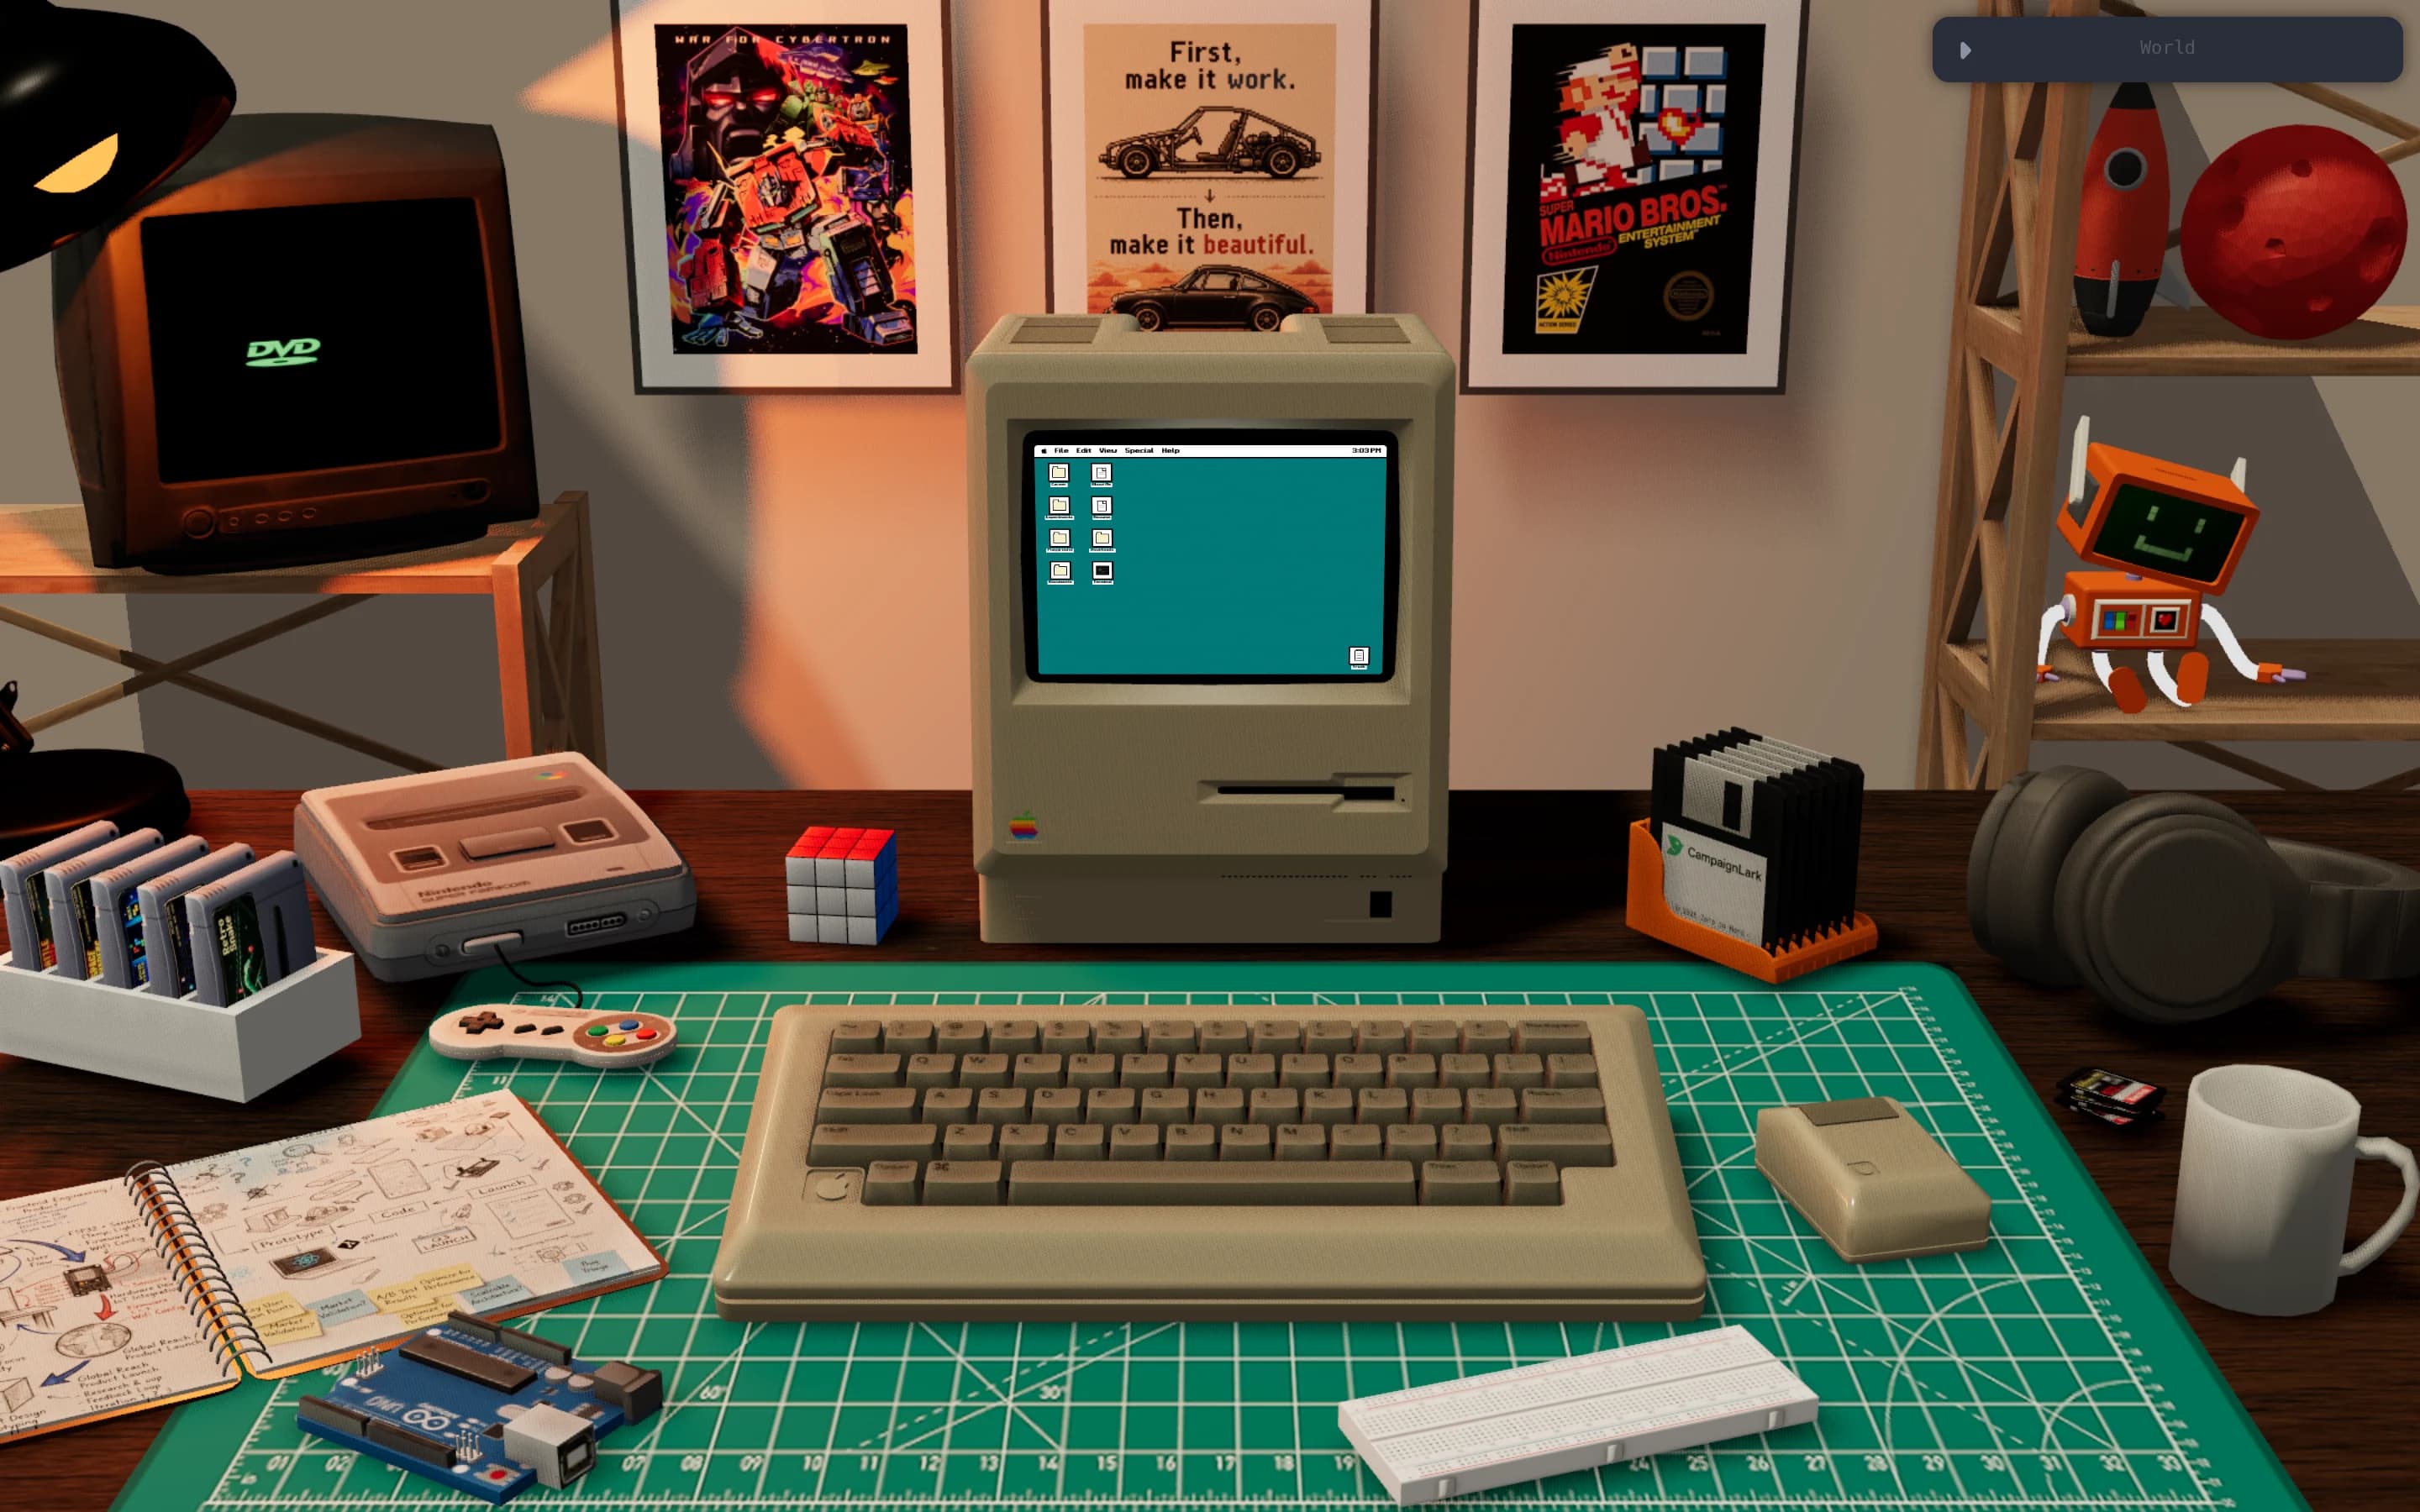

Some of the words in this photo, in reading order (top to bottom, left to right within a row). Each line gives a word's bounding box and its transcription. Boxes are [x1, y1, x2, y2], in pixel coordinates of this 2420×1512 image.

[675, 35, 711, 44] WAR
[726, 35, 760, 44] FOR
[776, 35, 891, 44] CYBERTRON
[1171, 40, 1241, 66] First,
[1126, 68, 1186, 90] make
[1198, 68, 1216, 90] it
[1228, 68, 1296, 90] work.
[1539, 200, 1575, 217] SUPER
[1539, 202, 1635, 247] MARIO
[1640, 184, 1728, 228] BROS.
[1177, 207, 1243, 232] Then,
[1618, 215, 1722, 244] ENTERTAINMENT
[1110, 234, 1169, 255] make
[1178, 234, 1195, 255] it
[1203, 234, 1314, 255] beautiful.
[1644, 232, 1695, 249] SYSTEM
[1547, 241, 1612, 262] Nintendo
[246, 338, 321, 358] DVD
[1124, 447, 1155, 455] Special
[1161, 447, 1181, 455] Help
[1687, 845, 1762, 883] CampaignLark
[418, 880, 493, 898] Nintendo
[217, 918, 231, 956] Retro
[224, 915, 238, 952] Snake
[478, 1179, 527, 1196] Launch
[381, 1205, 417, 1219] Code
[260, 1228, 324, 1249] Prototype
[423, 1234, 471, 1252] LAUNCH
[398, 1287, 418, 1295] Test
[320, 1298, 352, 1311] Market
[9, 1410, 46, 1422] Design
[325, 1455, 350, 1473] 02
[622, 1455, 647, 1473] 07
[681, 1455, 704, 1473] 08
[739, 1455, 764, 1473] 09
[803, 1455, 823, 1473] 10
[860, 1455, 879, 1473] 11
[919, 1455, 940, 1473] 12
[981, 1455, 999, 1473] 13
[1039, 1455, 1059, 1473] 14
[1097, 1455, 1118, 1473] 15
[1156, 1455, 1176, 1473] 16
[1216, 1455, 1236, 1473] 17
[1275, 1455, 1294, 1473] 18
[1335, 1455, 1355, 1473] 19
[1686, 1455, 1709, 1473] 25
[1745, 1455, 1770, 1473] 26
[1804, 1455, 1827, 1473] 27
[1865, 1455, 1889, 1473] 28
[1923, 1455, 1945, 1473] 29
[1981, 1455, 2006, 1473] 30
[2042, 1455, 2063, 1473] 31
[2101, 1455, 2125, 1473] 32
[2157, 1455, 2183, 1473] 33
